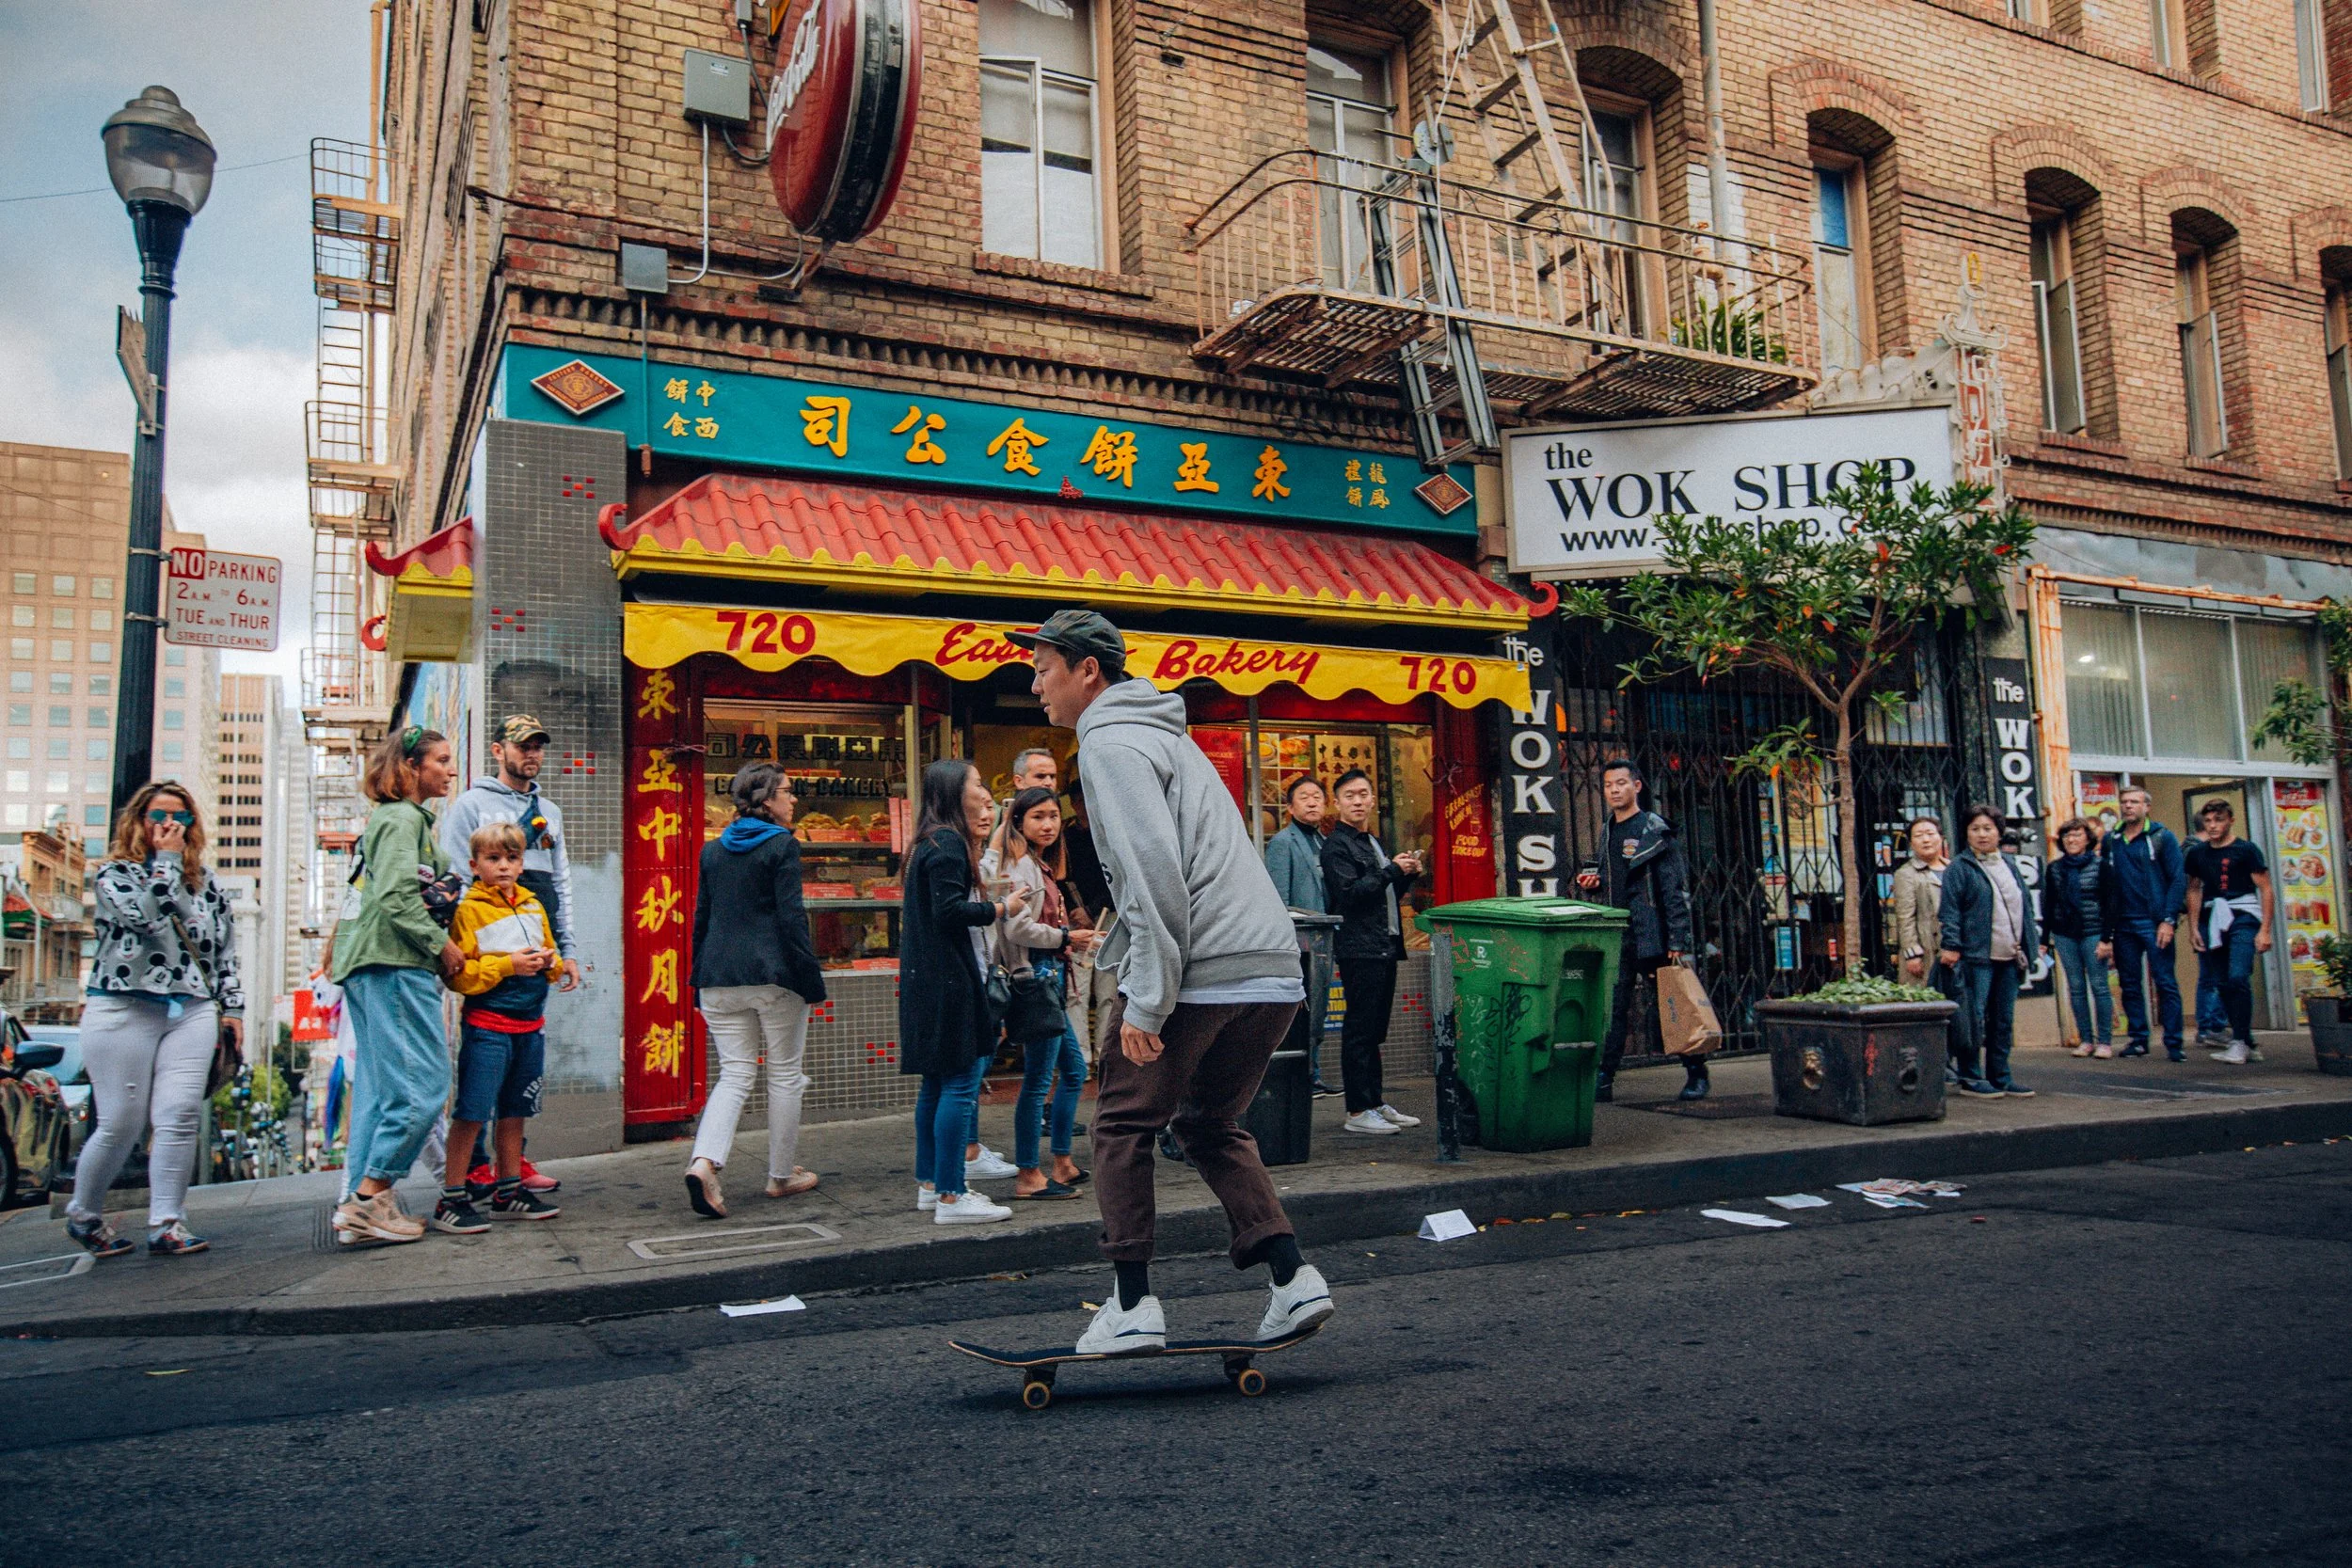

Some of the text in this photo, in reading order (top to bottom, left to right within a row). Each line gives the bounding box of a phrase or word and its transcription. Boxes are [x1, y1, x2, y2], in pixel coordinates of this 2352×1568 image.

[1544, 442, 1594, 470] the
[1546, 457, 1916, 523] WOK SHOP
[171, 550, 277, 584] NO PARKING
[175, 607, 270, 631] TUE AND THUR
[717, 610, 816, 656] 720
[176, 630, 269, 648] STREET CLEANING
[1502, 636, 1545, 667] the
[1152, 640, 1321, 685] Bakery
[1399, 656, 1477, 696] 720
[1994, 675, 2025, 704] the
[1510, 689, 1555, 815] WOK
[1995, 718, 2035, 819] WOK
